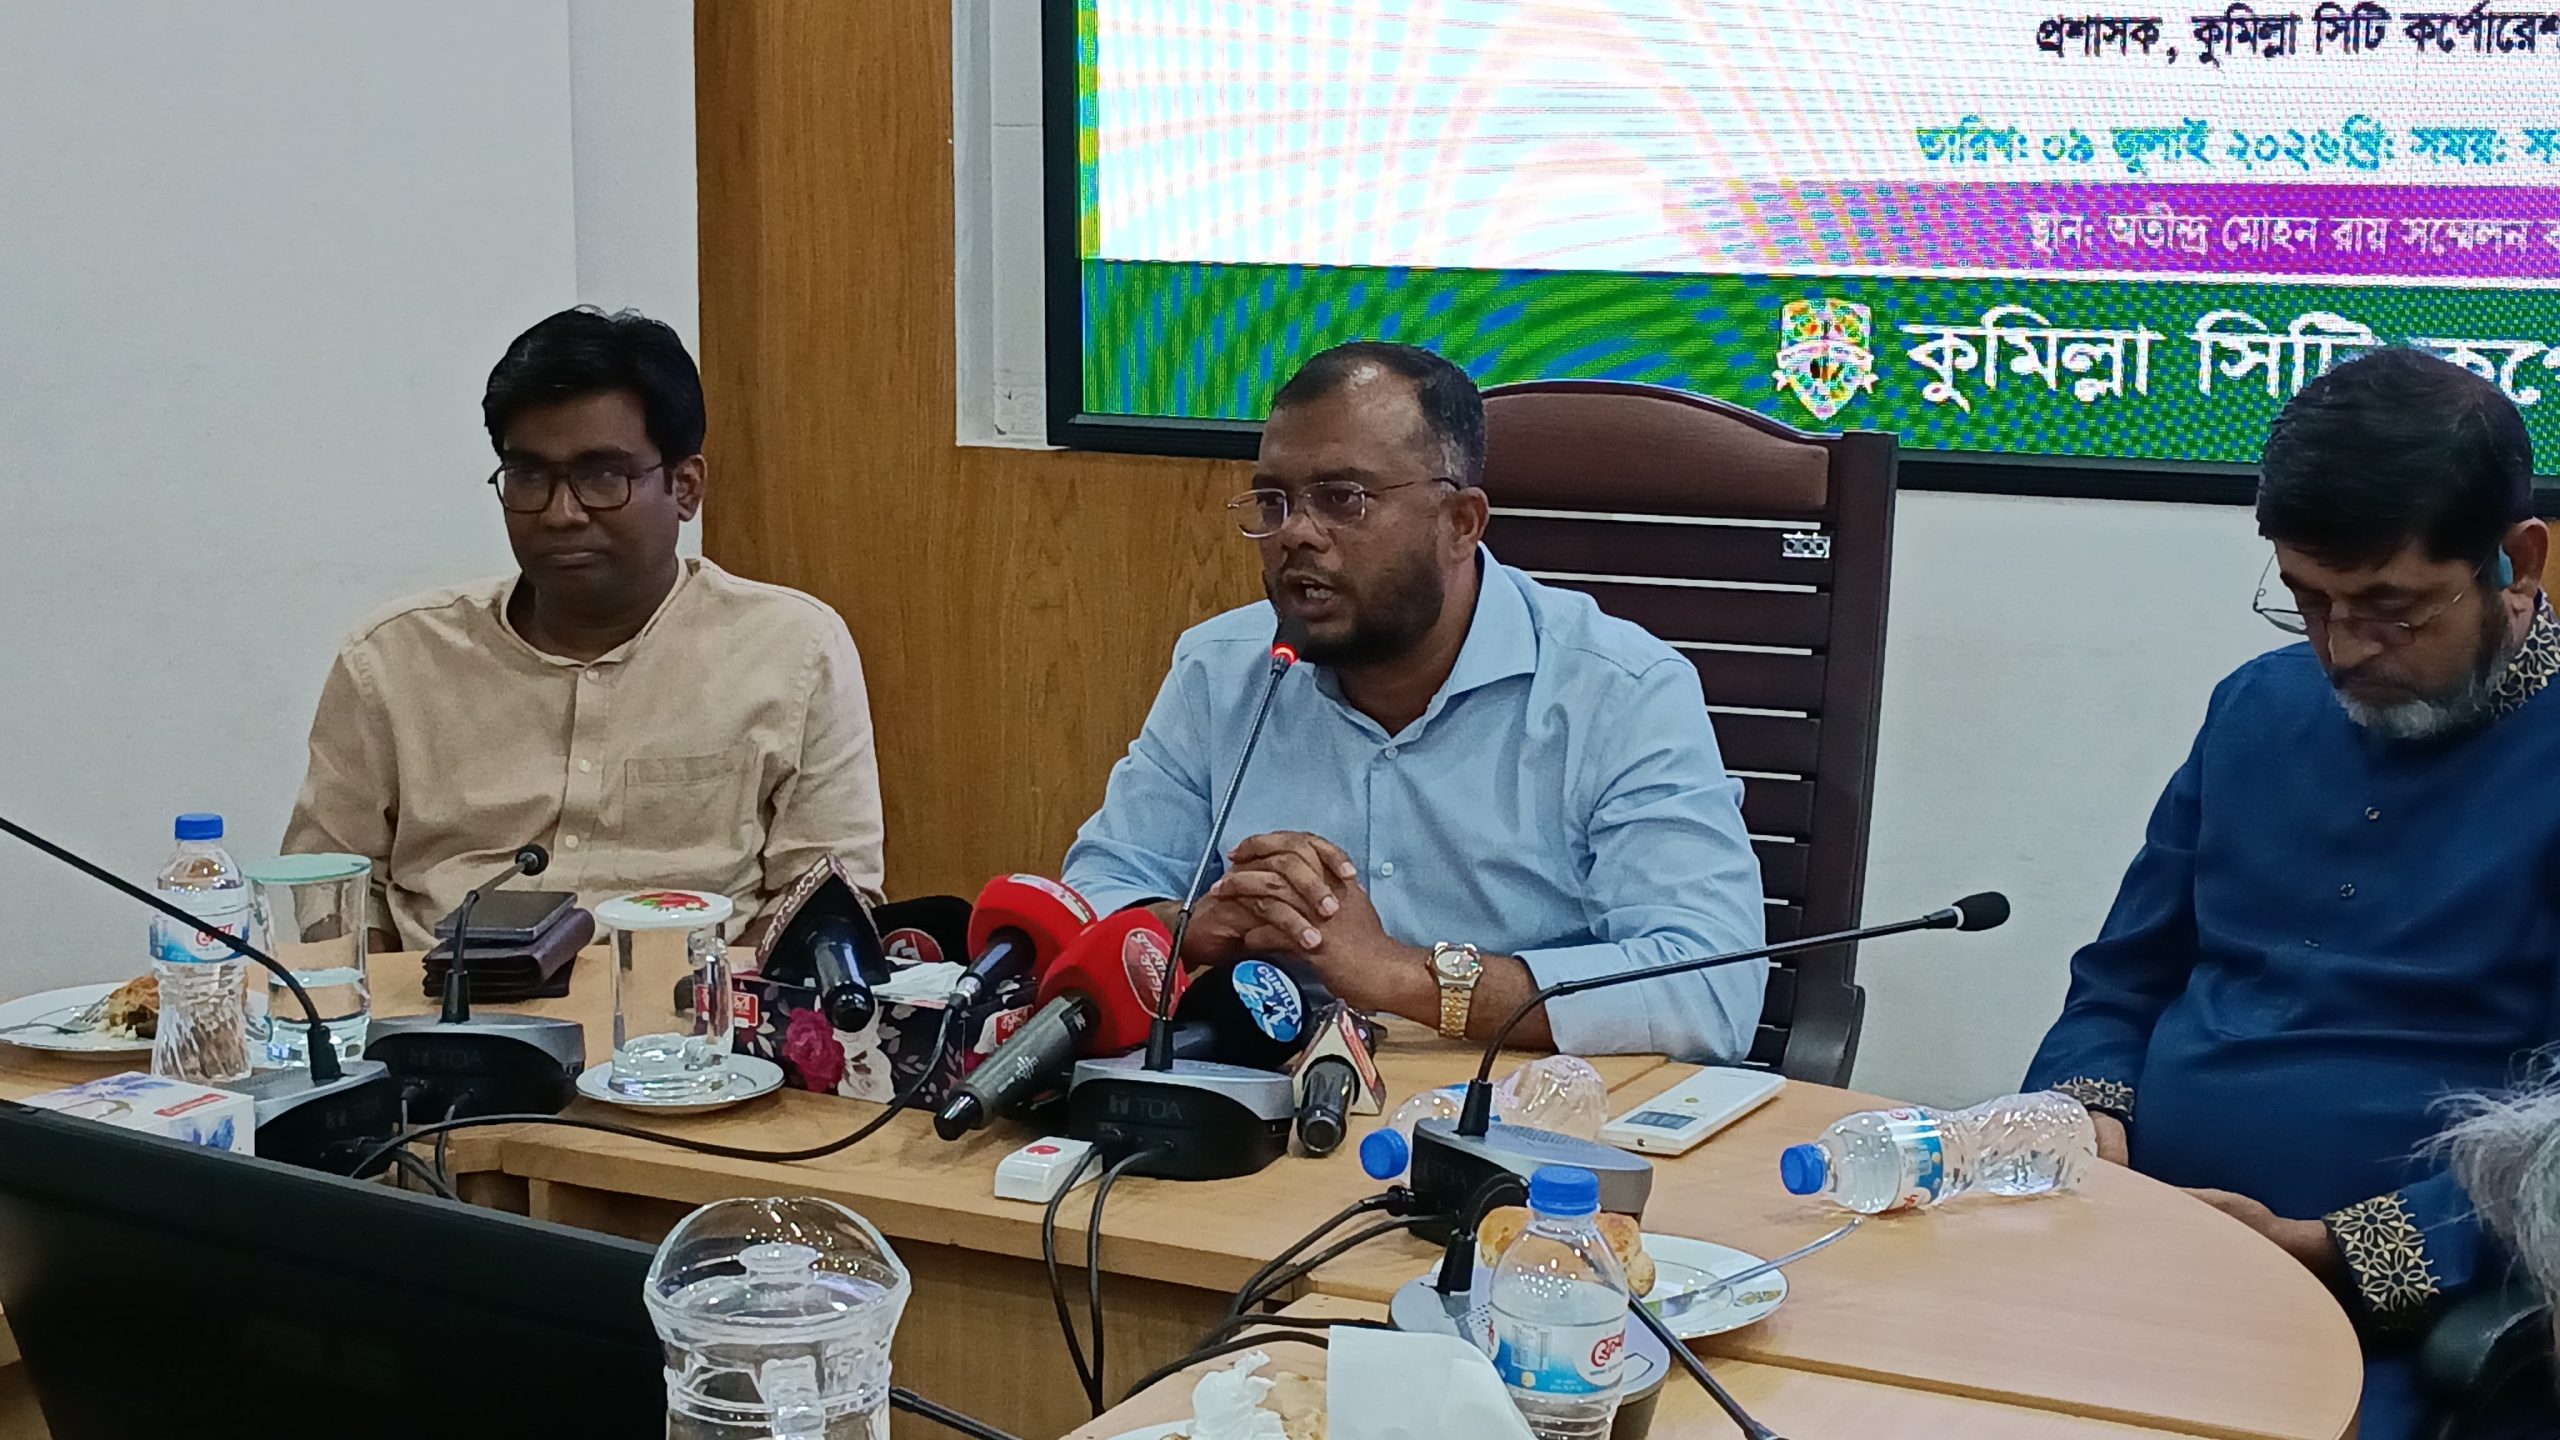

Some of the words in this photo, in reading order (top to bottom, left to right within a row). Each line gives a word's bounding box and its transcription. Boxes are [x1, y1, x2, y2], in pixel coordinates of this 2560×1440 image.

[2189, 2, 2303, 70] কুমিল্লা
[2312, 1, 2392, 55] সিটি
[1898, 304, 2167, 414] কুমিল্লা
[1138, 1098, 1184, 1121] TOA
